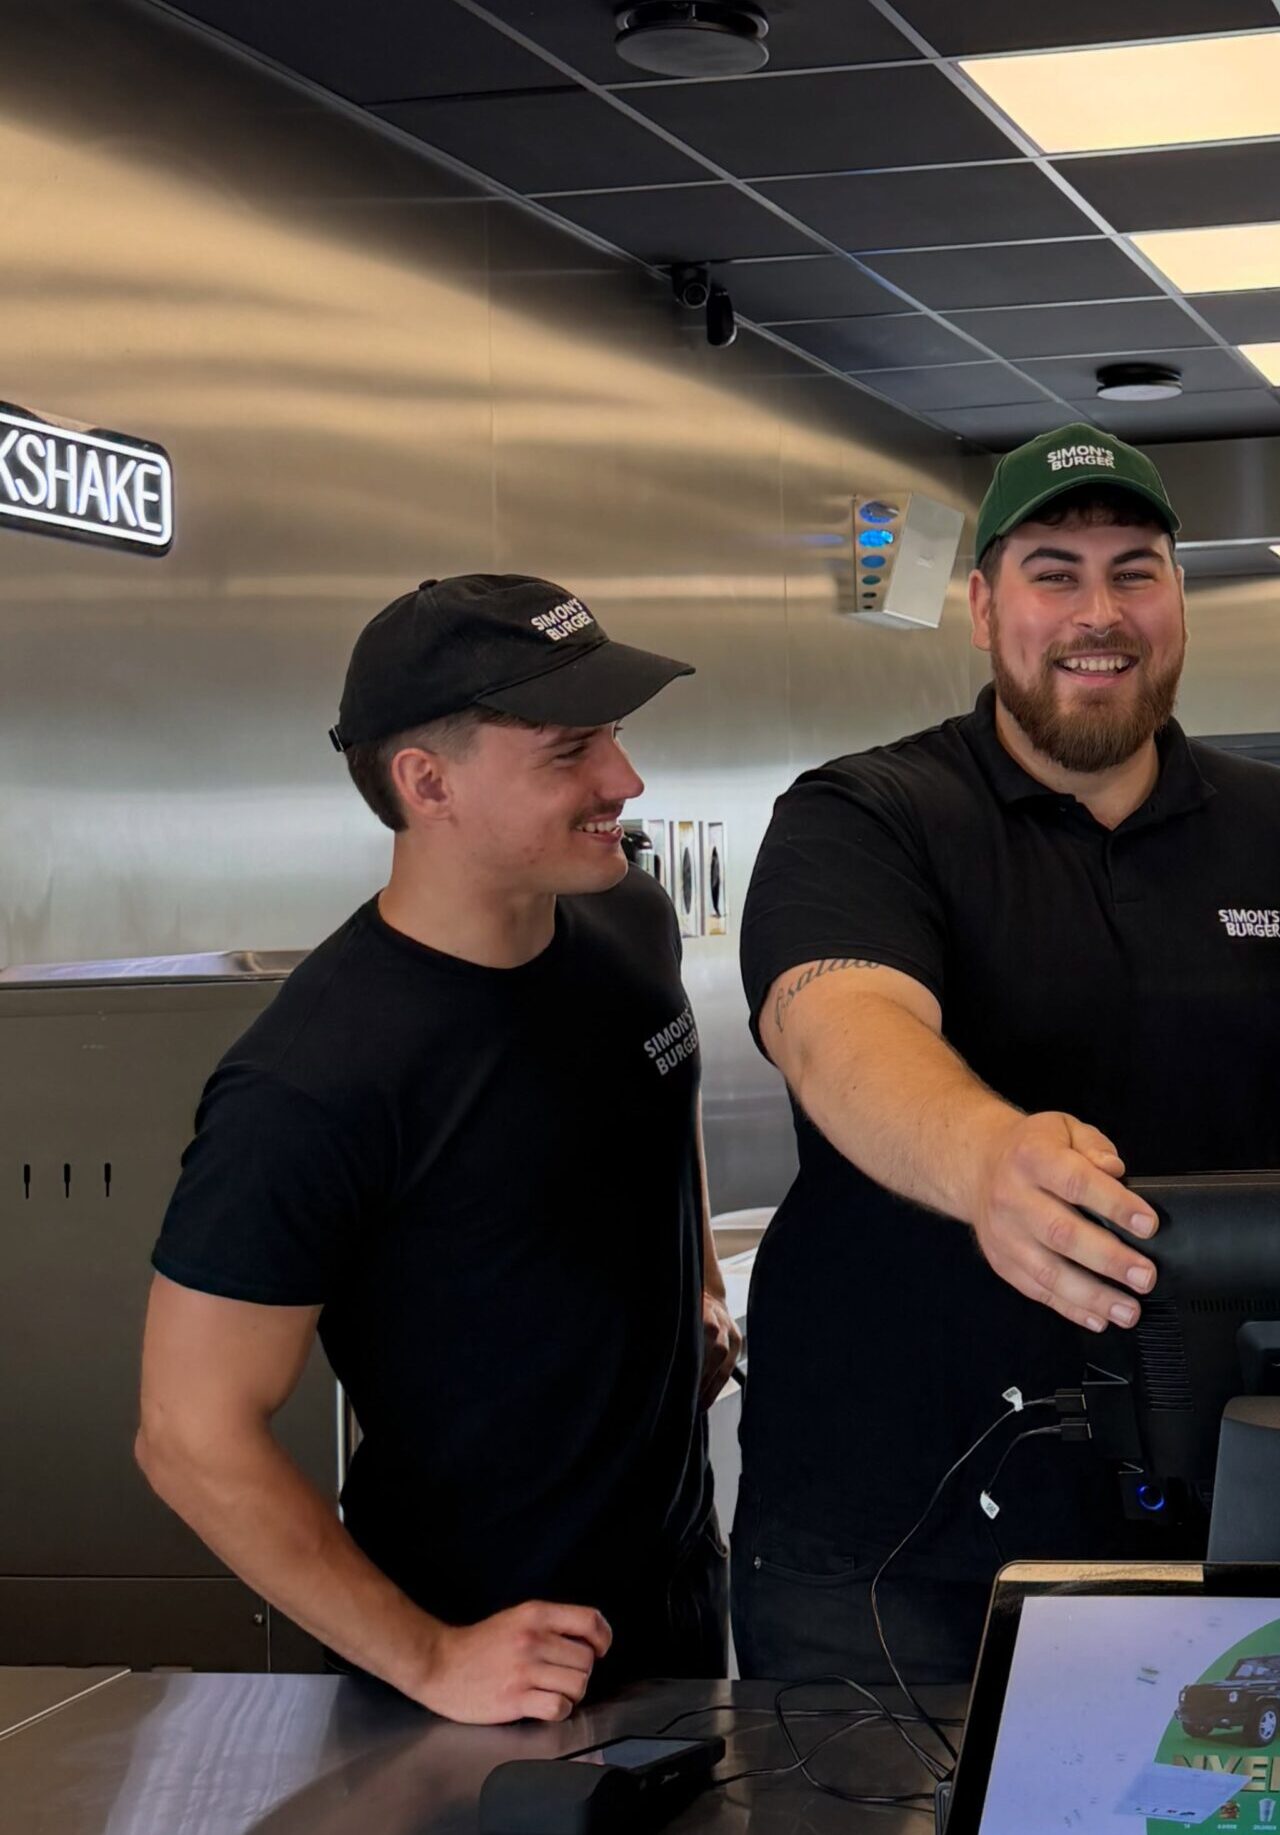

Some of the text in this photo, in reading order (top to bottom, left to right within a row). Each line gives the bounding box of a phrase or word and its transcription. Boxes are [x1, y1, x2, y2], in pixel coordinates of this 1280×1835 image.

[1047, 445, 1114, 463] SIMON'S
[1052, 455, 1115, 471] BURGER
[1218, 909, 1280, 925] SIMON'S
